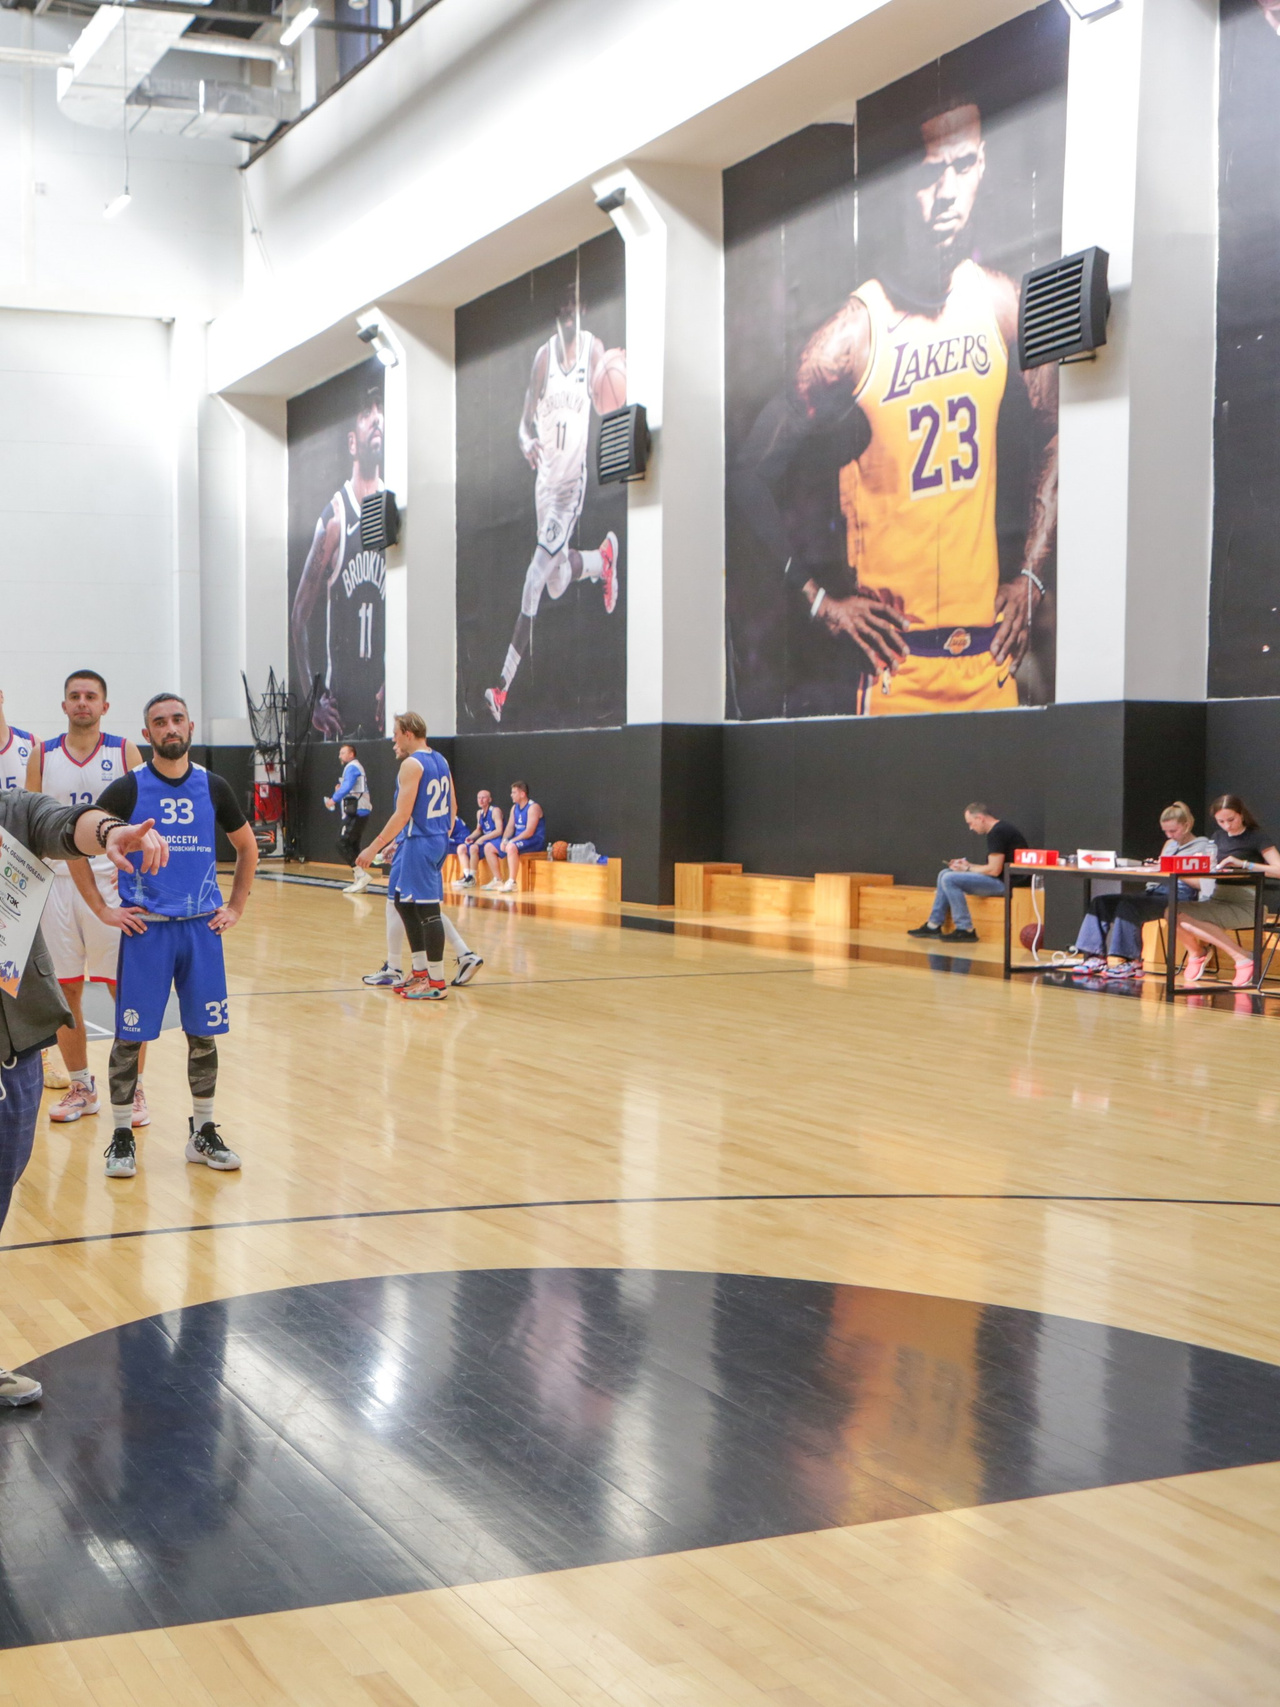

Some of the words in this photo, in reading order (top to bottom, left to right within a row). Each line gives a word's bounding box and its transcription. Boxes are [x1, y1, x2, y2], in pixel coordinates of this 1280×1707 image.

[882, 334, 991, 402] LAKERS
[556, 420, 567, 450] 11
[908, 395, 981, 500] 23
[359, 602, 373, 658] 11
[160, 798, 194, 824] 33
[426, 775, 450, 819] 22
[160, 835, 198, 844] РОССЕТИ
